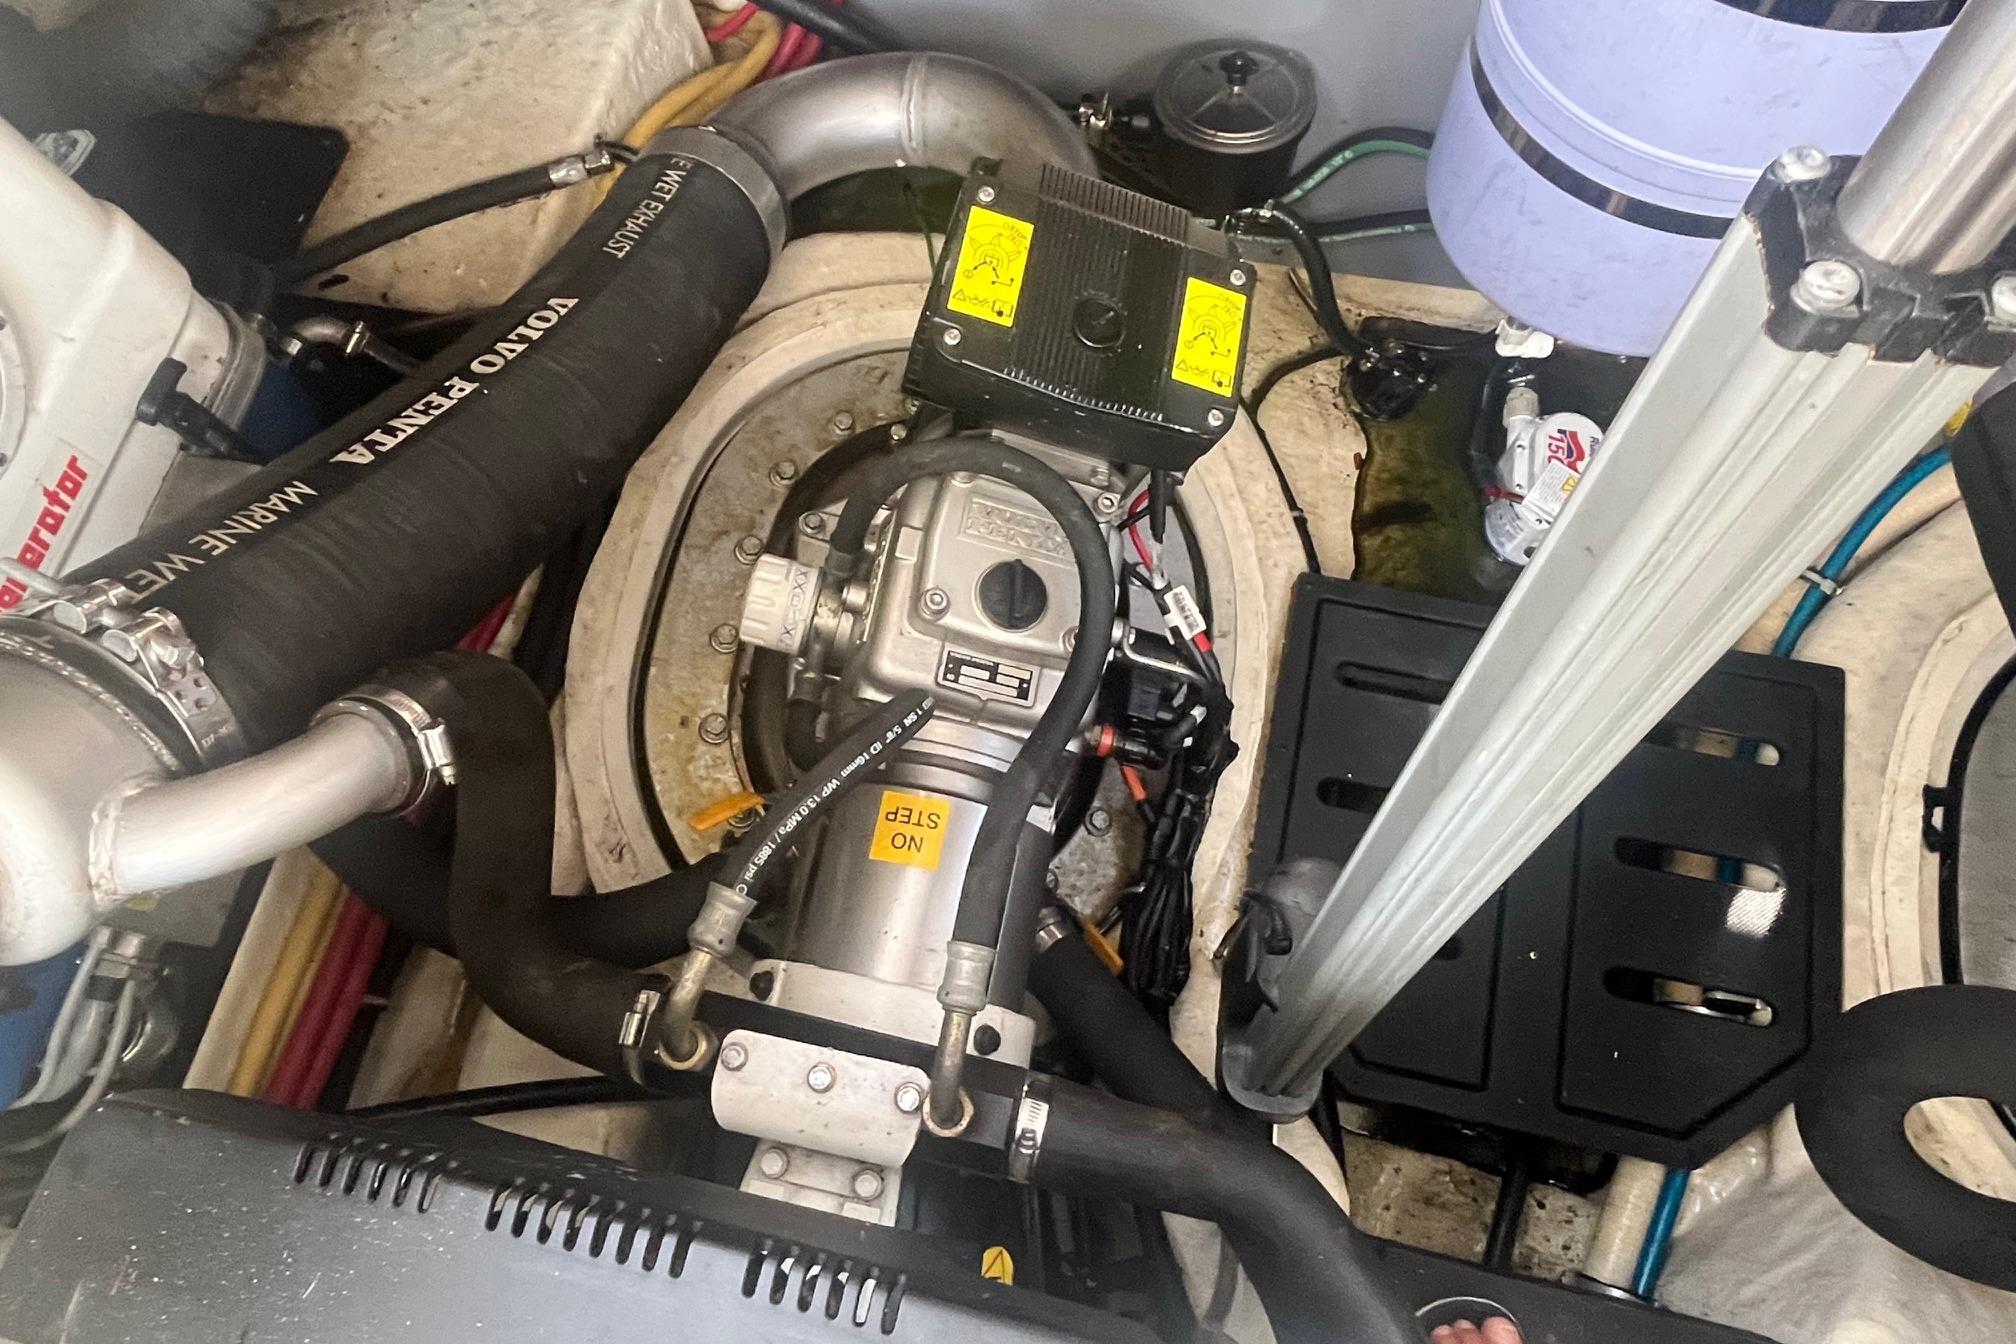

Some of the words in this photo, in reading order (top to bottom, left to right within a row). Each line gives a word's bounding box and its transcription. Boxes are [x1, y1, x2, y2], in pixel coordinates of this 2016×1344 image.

[651, 169, 687, 202] WET
[602, 200, 664, 259] EXHAUST
[470, 297, 580, 374] VOLVO
[329, 375, 480, 465] PENTA
[188, 480, 318, 556] MARINE
[869, 741, 883, 754] ID
[840, 752, 870, 777] 16mm
[822, 778, 841, 797] WP
[800, 795, 820, 815] 13.0
[778, 812, 802, 835] MPa
[885, 805, 941, 830] STEP
[754, 842, 776, 866] 1885
[891, 832, 923, 853] NO
[744, 863, 758, 882] psi
